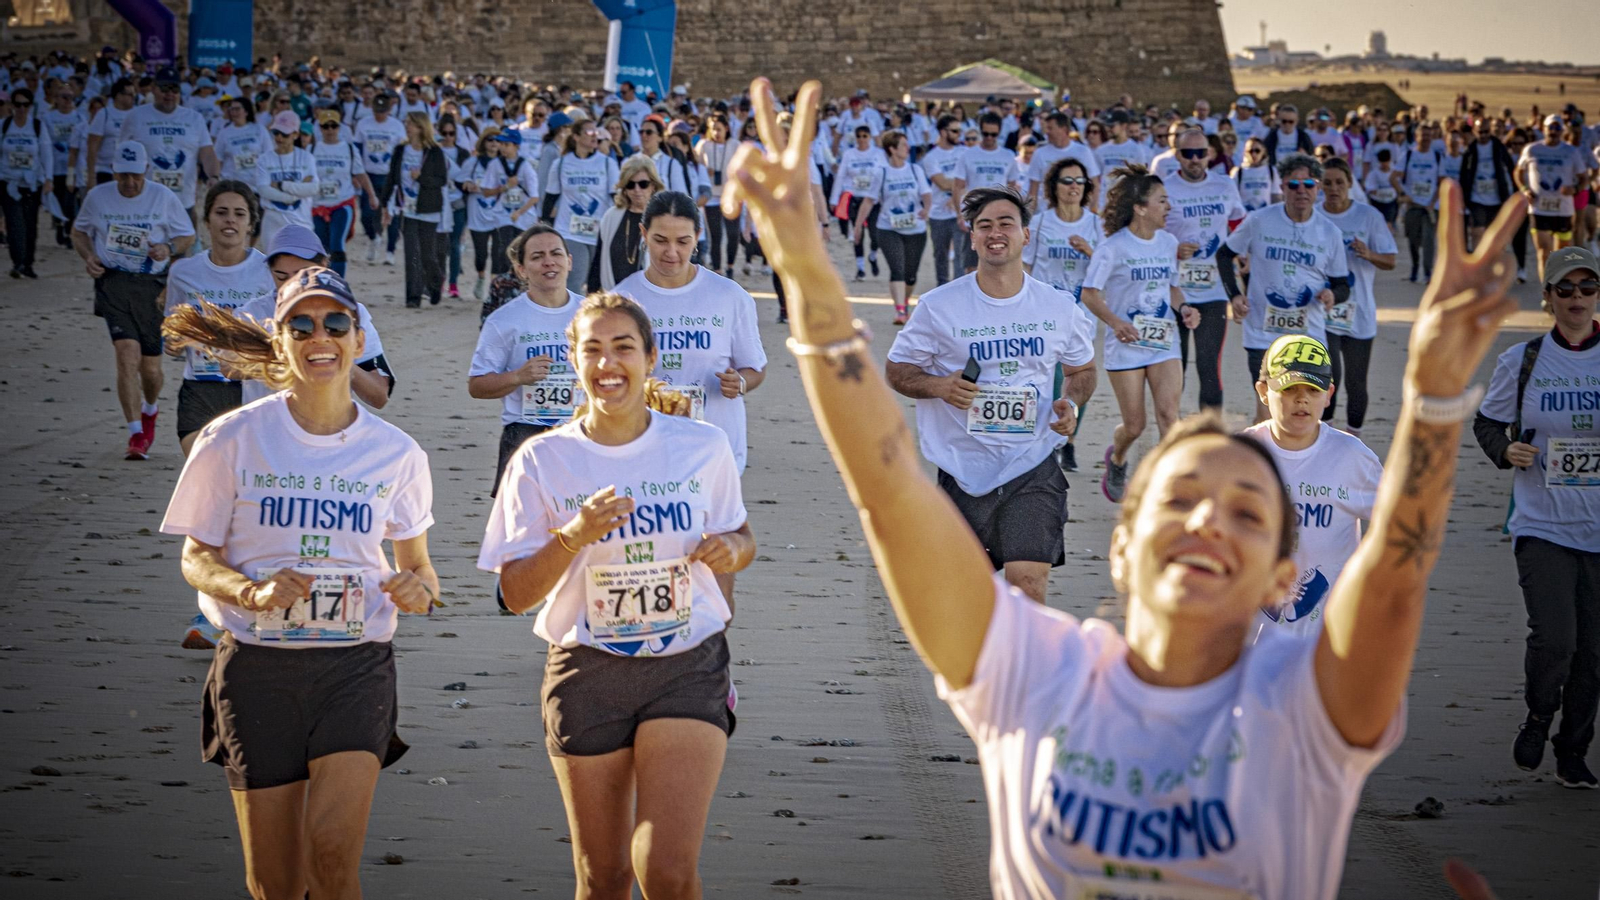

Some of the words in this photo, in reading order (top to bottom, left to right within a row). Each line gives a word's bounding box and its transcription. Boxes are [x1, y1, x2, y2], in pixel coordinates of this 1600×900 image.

[1183, 203, 1225, 218] AUTISMO
[115, 234, 141, 249] 448
[1265, 246, 1316, 267] AUTISMO
[1131, 266, 1170, 281] AUTISM
[1186, 270, 1211, 282] 132
[228, 288, 254, 300] favor
[669, 317, 674, 326] a
[679, 315, 707, 327] favor
[711, 314, 724, 327] del
[960, 325, 996, 337] marcha
[1001, 326, 1007, 335] a
[1012, 322, 1038, 333] favor
[1043, 320, 1057, 331] del
[520, 332, 549, 343] marcha
[554, 332, 559, 340] a
[655, 330, 711, 351] TISMO
[1141, 326, 1165, 340] 123
[526, 344, 569, 362] AUTIS
[969, 337, 1044, 361] AUTISMO
[1271, 341, 1325, 366] 46
[1534, 376, 1569, 388] marcha
[1575, 377, 1580, 387] a
[1585, 375, 1600, 387] fav
[535, 387, 571, 405] 349
[1541, 391, 1600, 412] AUTIS
[983, 400, 1024, 421] 806
[1562, 453, 1600, 473] 827
[242, 470, 246, 486] I
[254, 472, 305, 489] marcha
[314, 476, 322, 490] a
[330, 474, 369, 495] favor
[376, 481, 392, 498] del
[1298, 482, 1332, 497] favor
[1337, 484, 1350, 501] del
[553, 496, 560, 513] I
[641, 481, 682, 496] favor
[688, 477, 703, 494] del
[260, 496, 373, 533] AUTISMO
[599, 501, 692, 542] TISMO
[608, 584, 673, 617] 718
